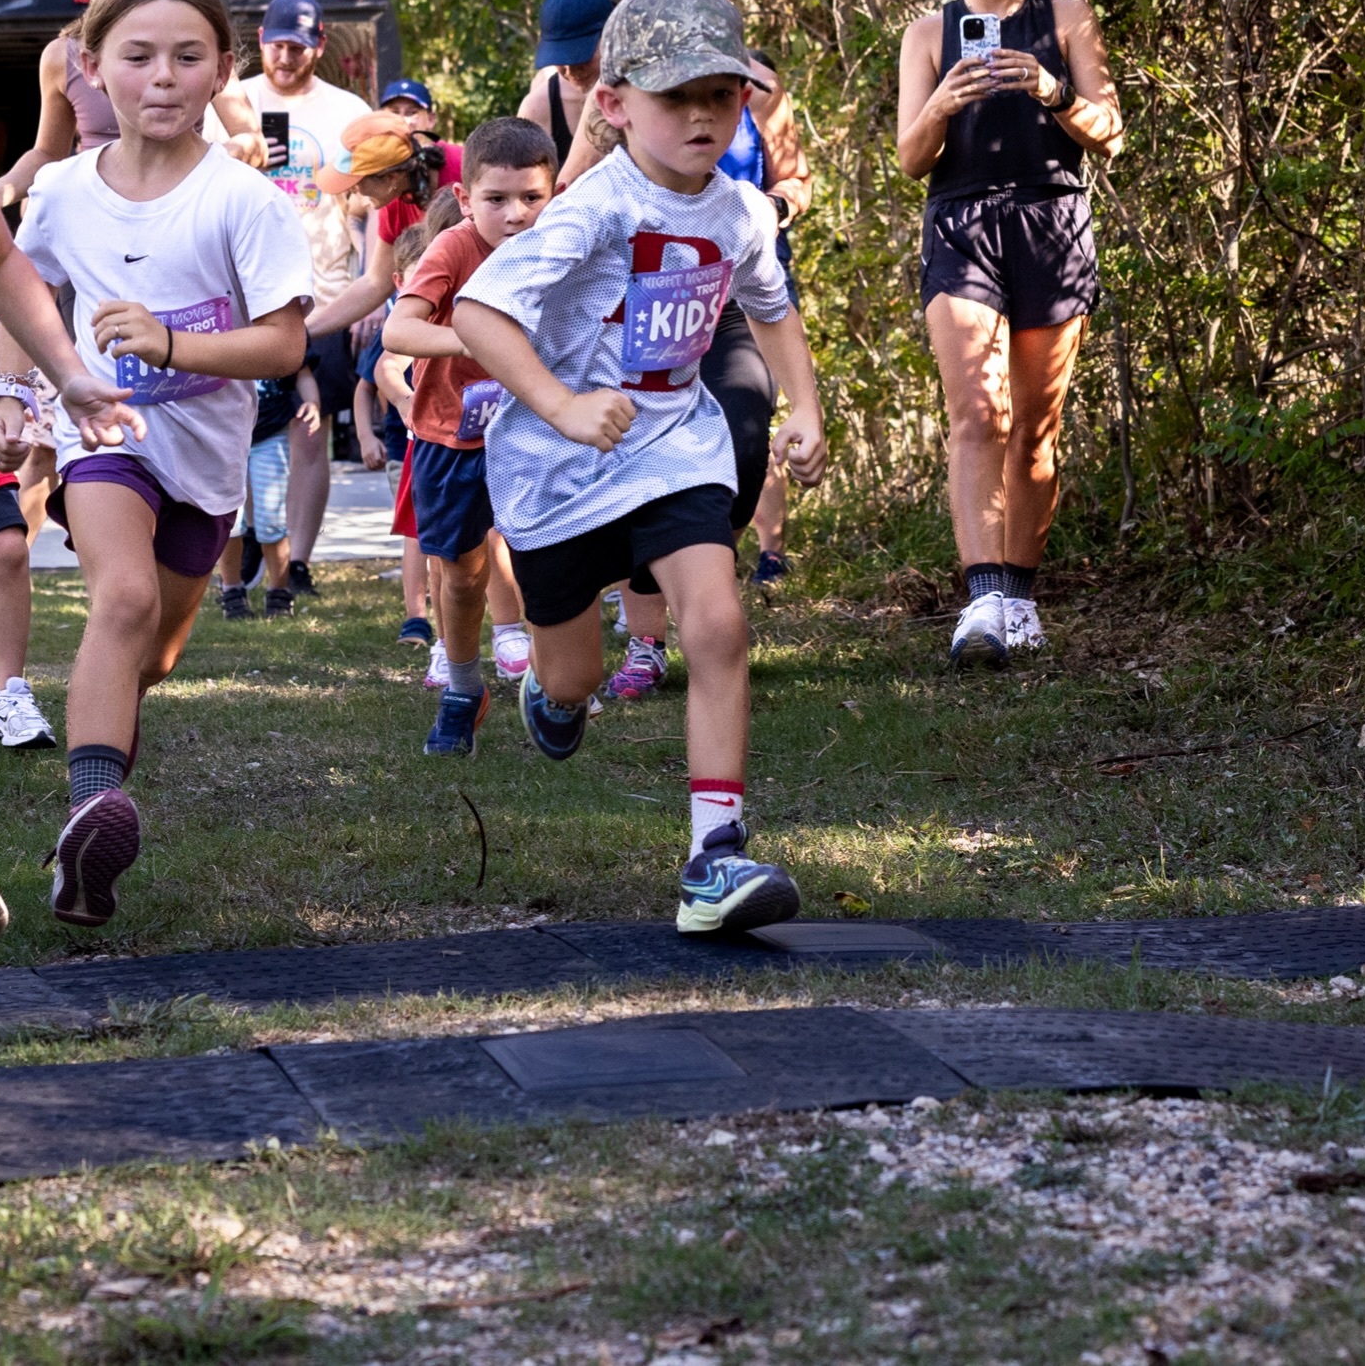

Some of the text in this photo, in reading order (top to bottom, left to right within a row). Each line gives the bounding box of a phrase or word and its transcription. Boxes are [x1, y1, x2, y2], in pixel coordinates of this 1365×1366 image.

[642, 266, 723, 290] NIGHT MOVES
[696, 280, 722, 296] TROT
[171, 303, 215, 326] MOVES
[185, 317, 217, 333] TROT
[649, 292, 720, 342] KIDS
